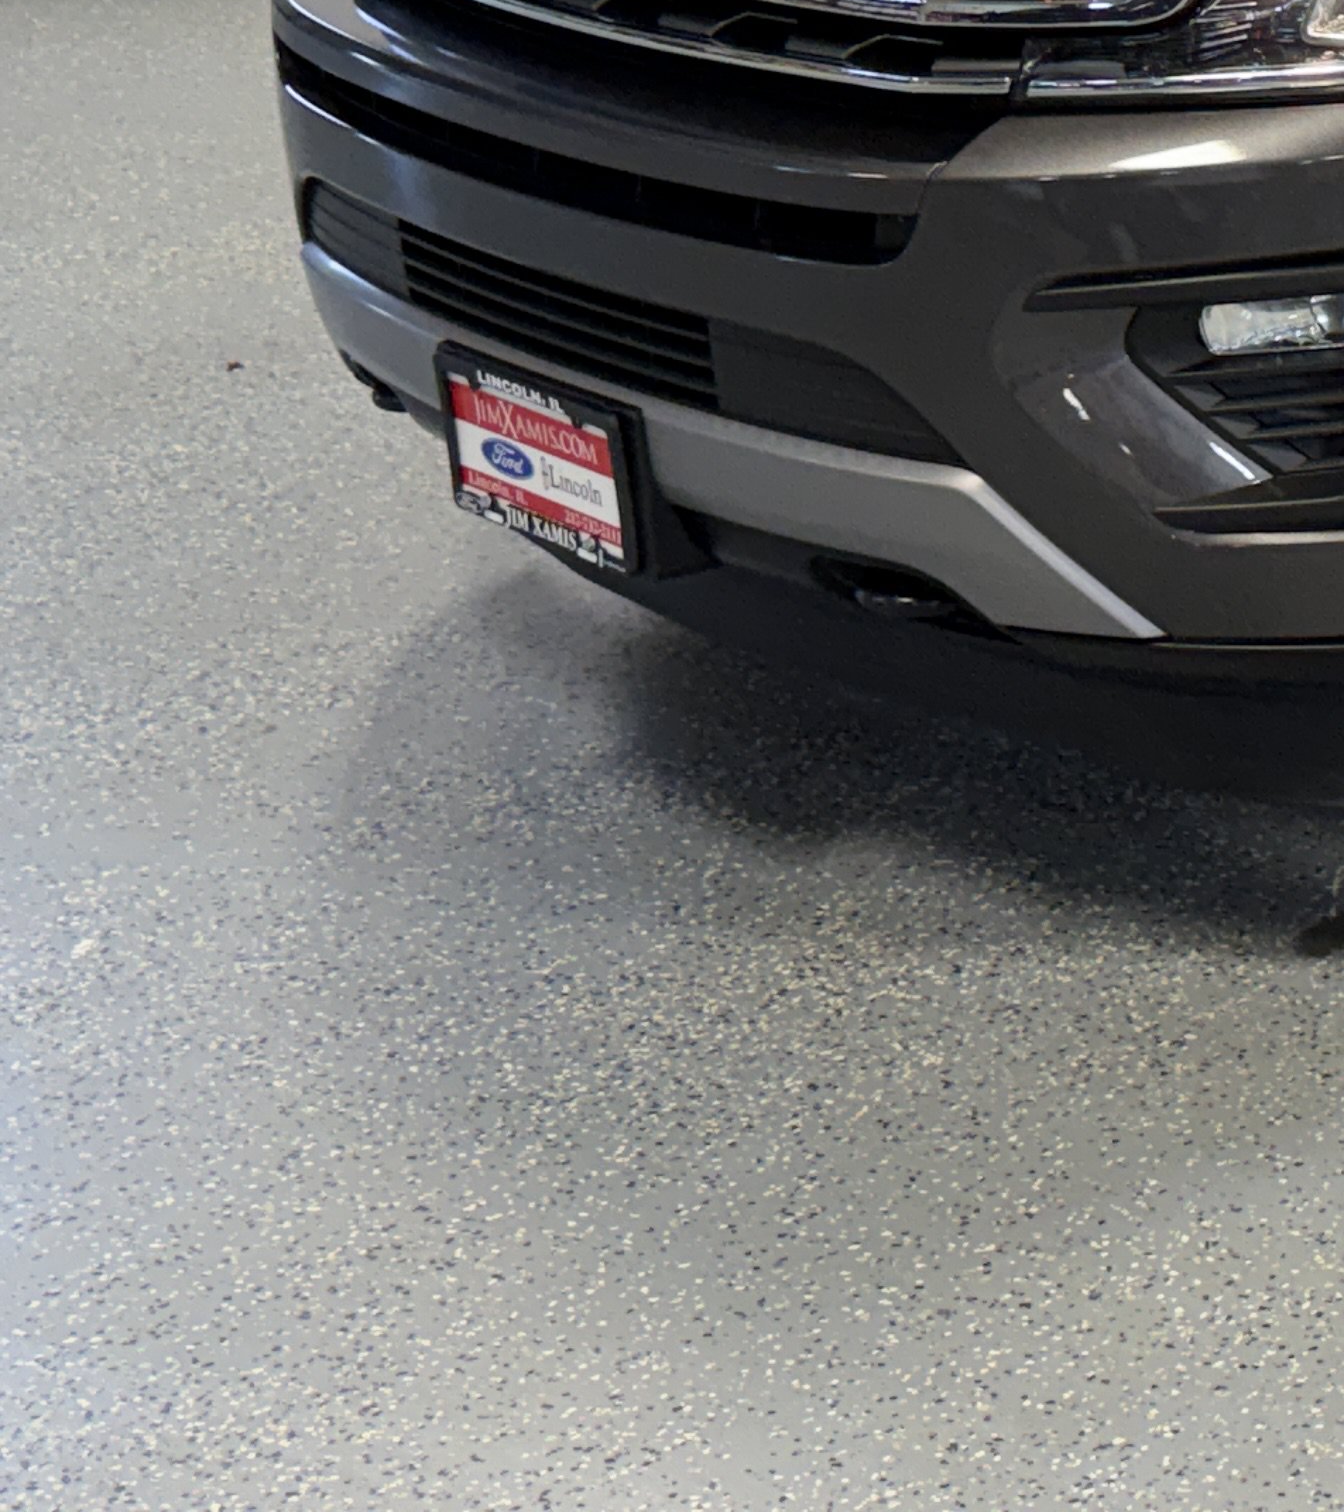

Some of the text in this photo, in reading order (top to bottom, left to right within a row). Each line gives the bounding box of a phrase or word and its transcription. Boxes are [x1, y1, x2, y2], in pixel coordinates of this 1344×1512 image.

[491, 442, 525, 474] Ford
[551, 464, 603, 507] Lincoln
[504, 508, 529, 533] JIM
[531, 516, 577, 552] XAMIS
